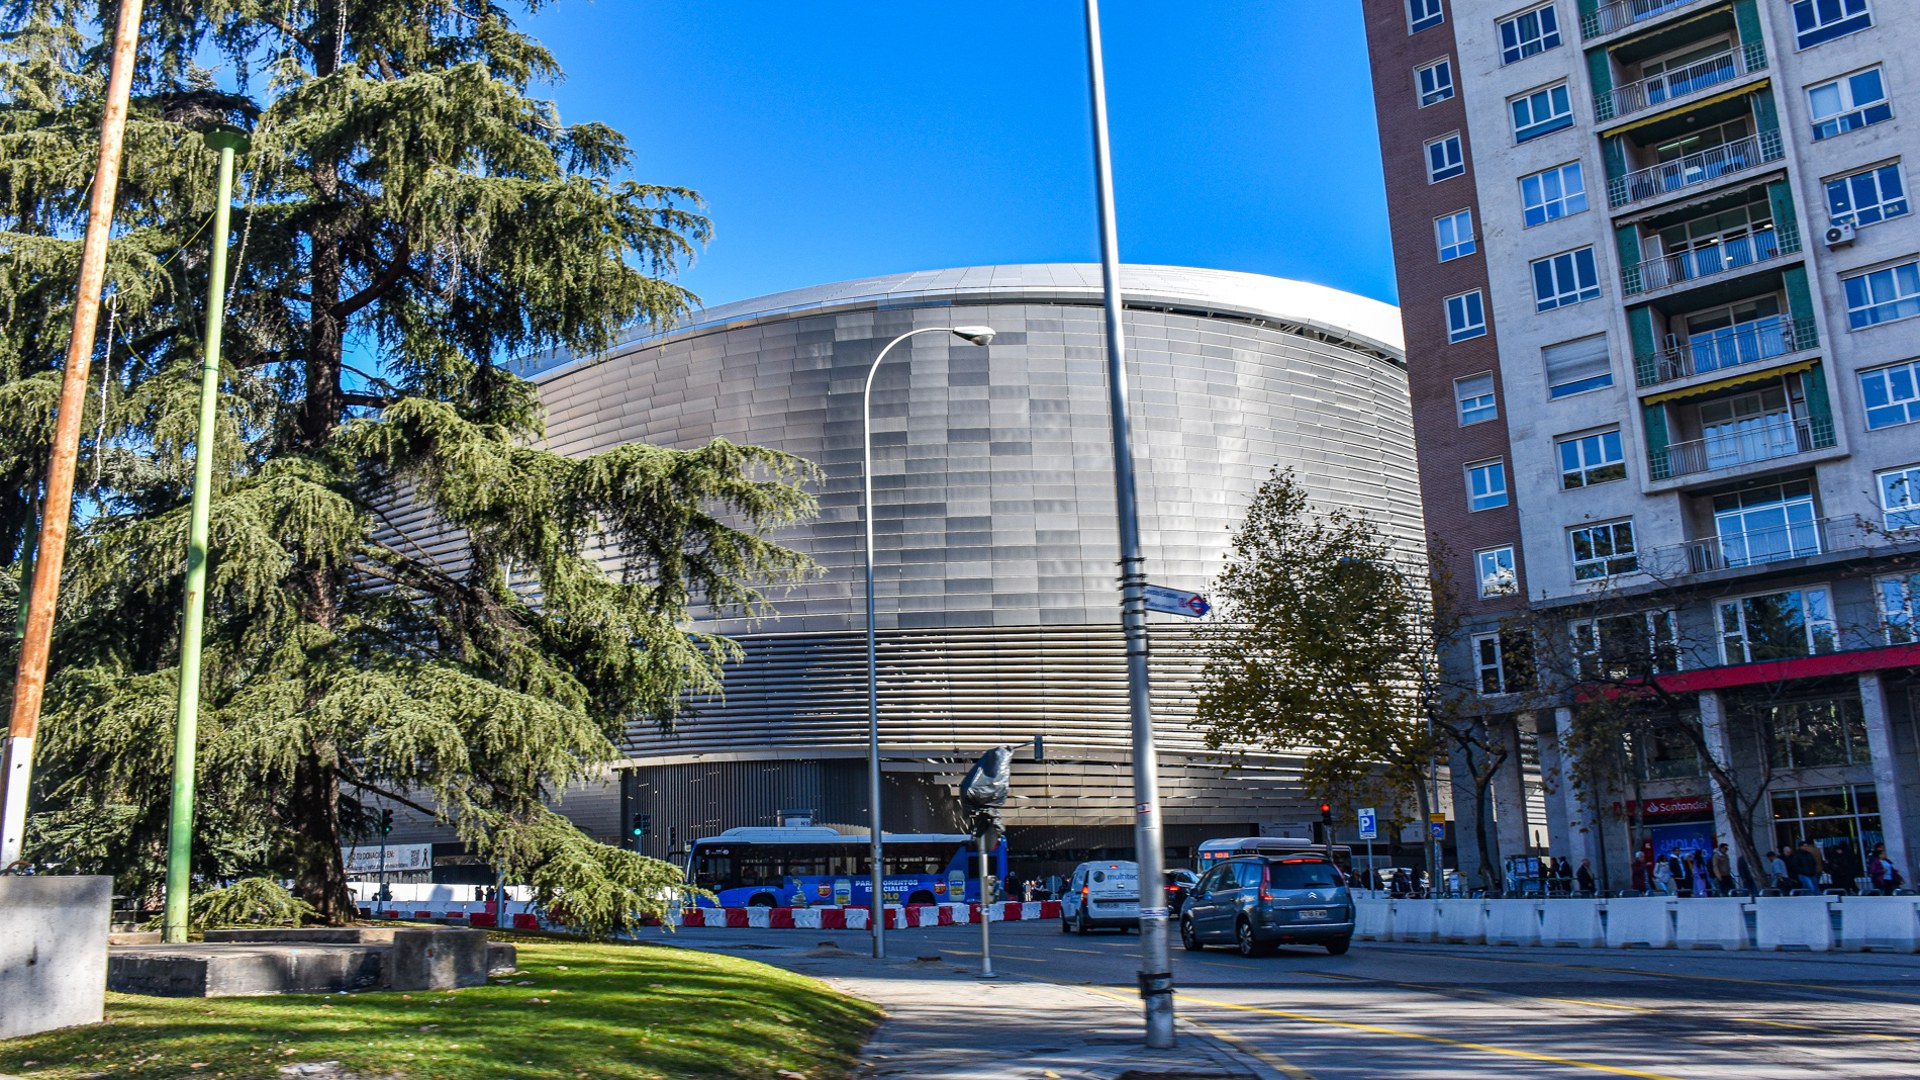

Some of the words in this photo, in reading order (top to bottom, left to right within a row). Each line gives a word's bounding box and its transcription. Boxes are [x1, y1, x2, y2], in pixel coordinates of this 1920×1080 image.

[1659, 801, 1708, 812] Santander
[1361, 817, 1370, 831] P
[363, 851, 386, 859] DONACI
[882, 892, 899, 900] OLO
